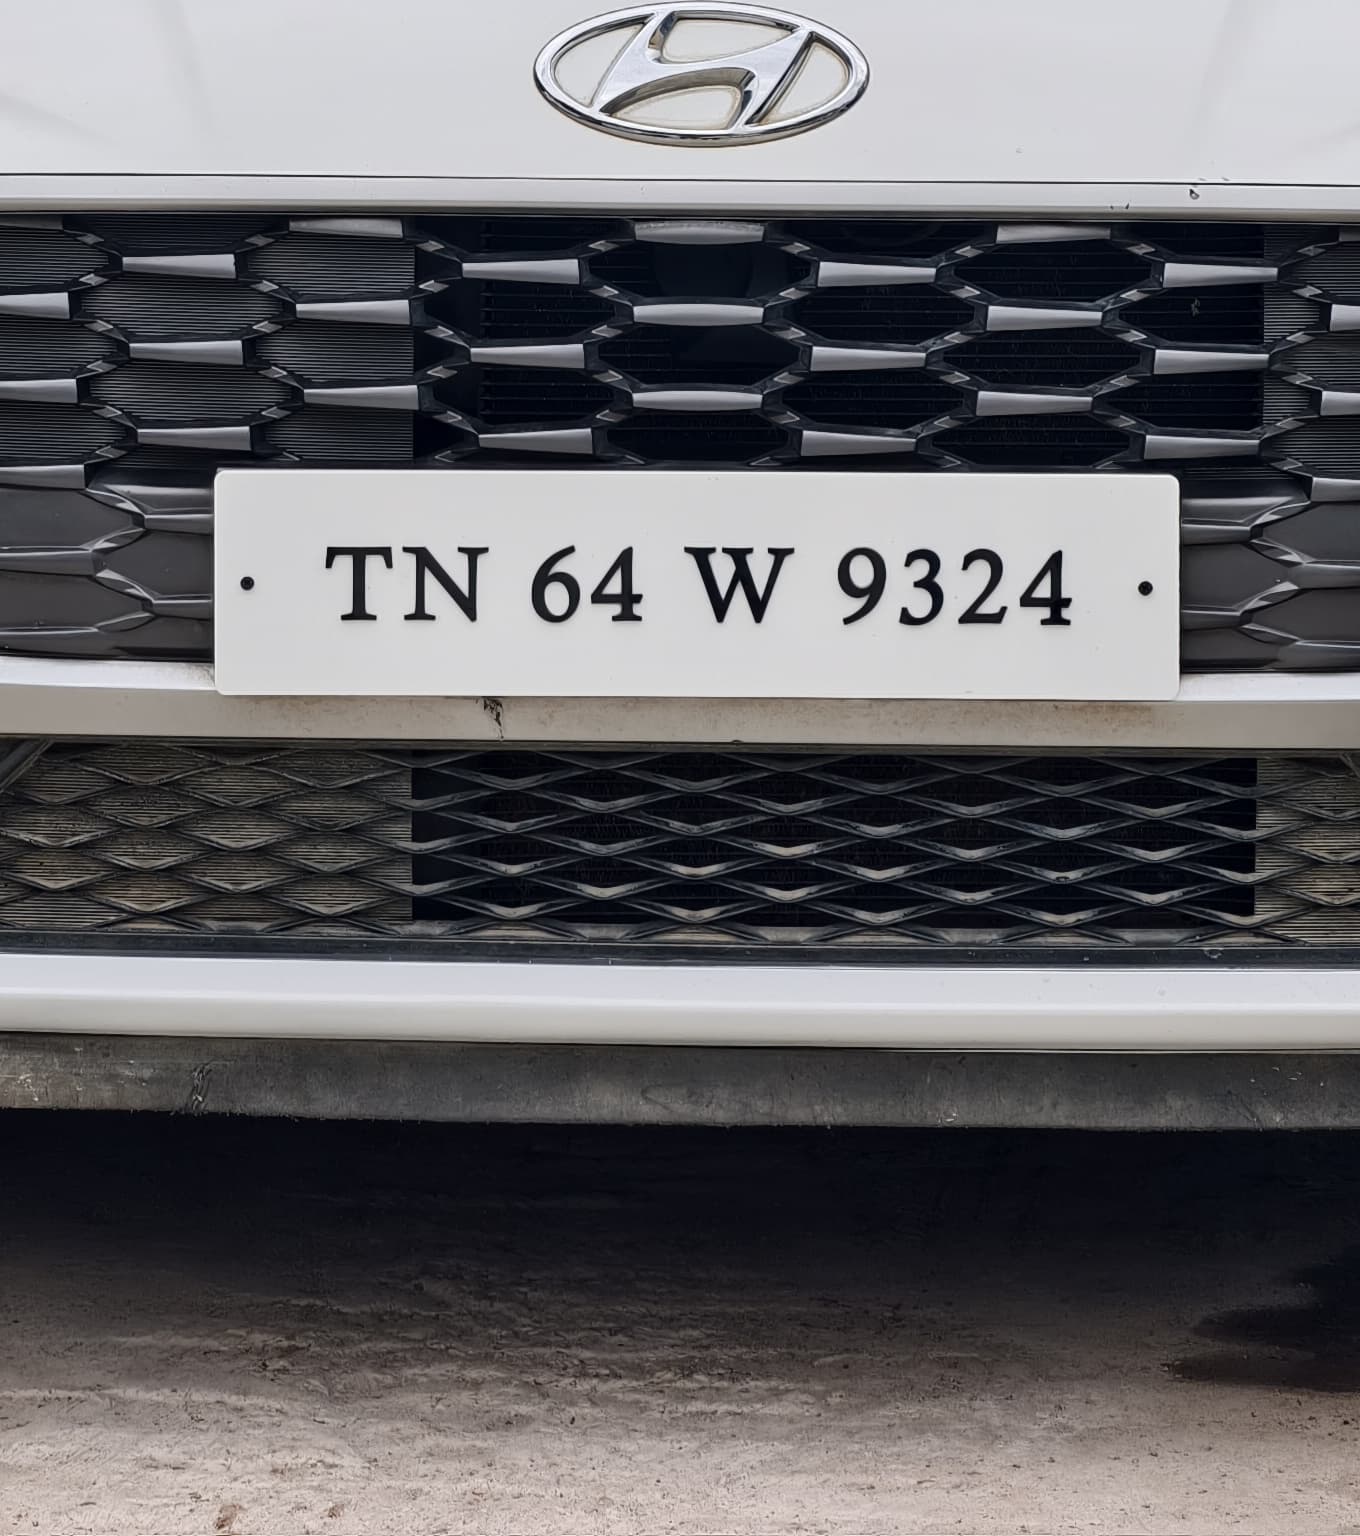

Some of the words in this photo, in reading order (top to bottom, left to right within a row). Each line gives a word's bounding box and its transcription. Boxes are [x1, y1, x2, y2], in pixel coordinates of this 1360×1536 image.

[326, 546, 490, 623] TN
[531, 544, 644, 624] 64
[683, 546, 795, 624] W
[837, 546, 1073, 627] 9324
